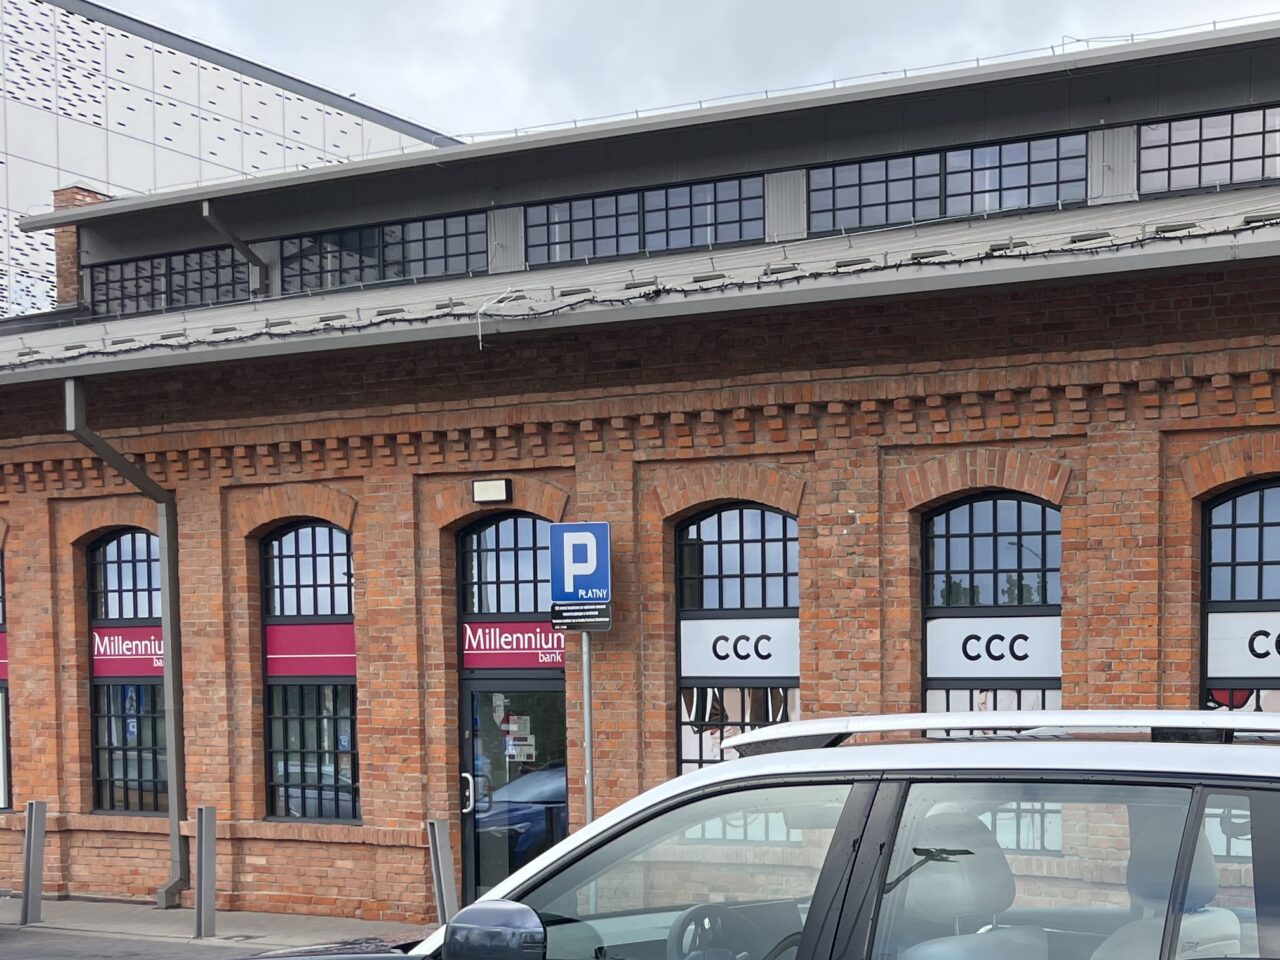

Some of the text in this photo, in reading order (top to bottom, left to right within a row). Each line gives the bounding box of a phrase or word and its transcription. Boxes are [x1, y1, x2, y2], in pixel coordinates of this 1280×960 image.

[563, 532, 598, 593] P
[578, 589, 608, 599] PŁATNY
[93, 631, 164, 655] Millenniu
[711, 634, 773, 661] CCC
[961, 633, 1030, 662] CCC
[538, 651, 563, 663] bank
